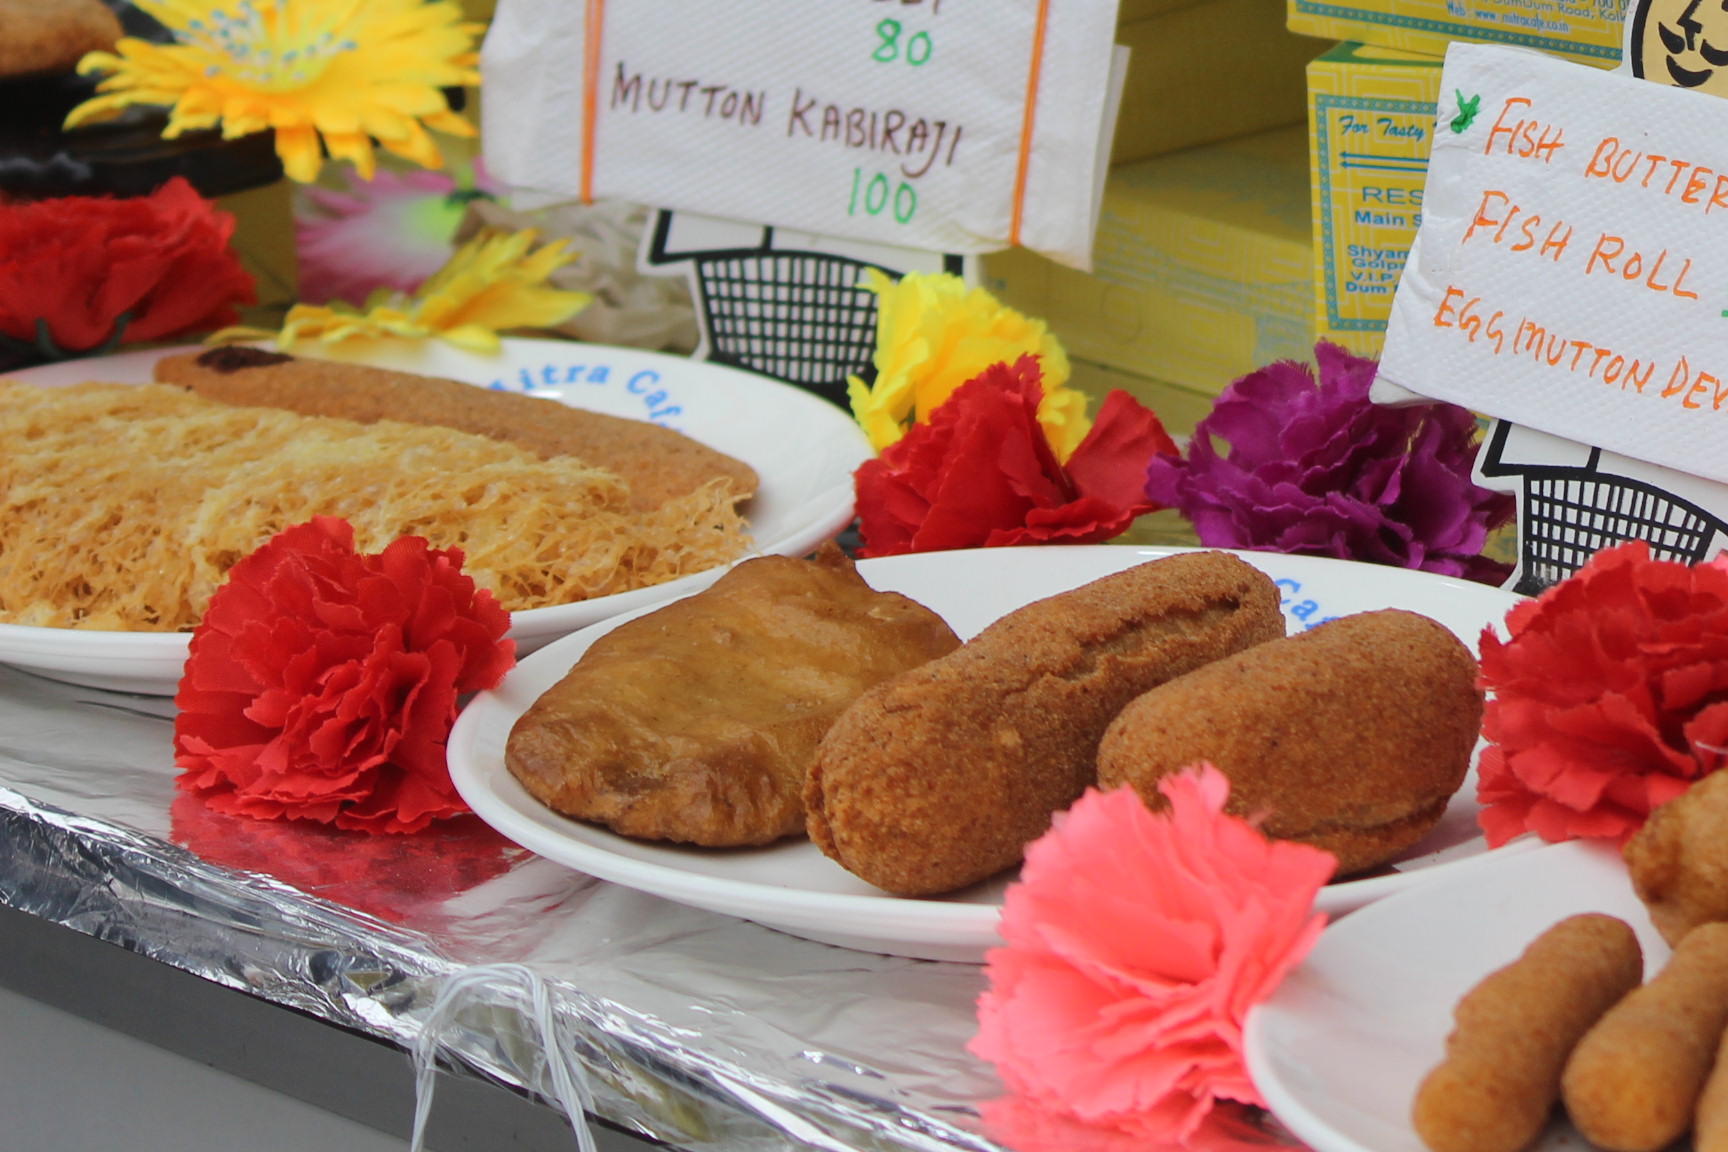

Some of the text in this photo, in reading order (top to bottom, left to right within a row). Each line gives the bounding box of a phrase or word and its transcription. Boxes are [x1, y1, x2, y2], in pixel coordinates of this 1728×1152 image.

[871, 17, 933, 66] 80
[610, 61, 965, 179] MUTTON KABIRAJI
[1338, 115, 1370, 136] For
[1376, 117, 1426, 142] Tasty
[1483, 96, 1566, 165] FISH
[848, 167, 918, 224] 100
[1354, 209, 1405, 227] Main
[1462, 190, 1574, 262] FISH
[1586, 231, 1699, 301] ROLL
[1345, 281, 1388, 295] Dum
[1433, 285, 1504, 356] EGG
[1512, 319, 1655, 395] MUTTON
[626, 368, 684, 433] Caf
